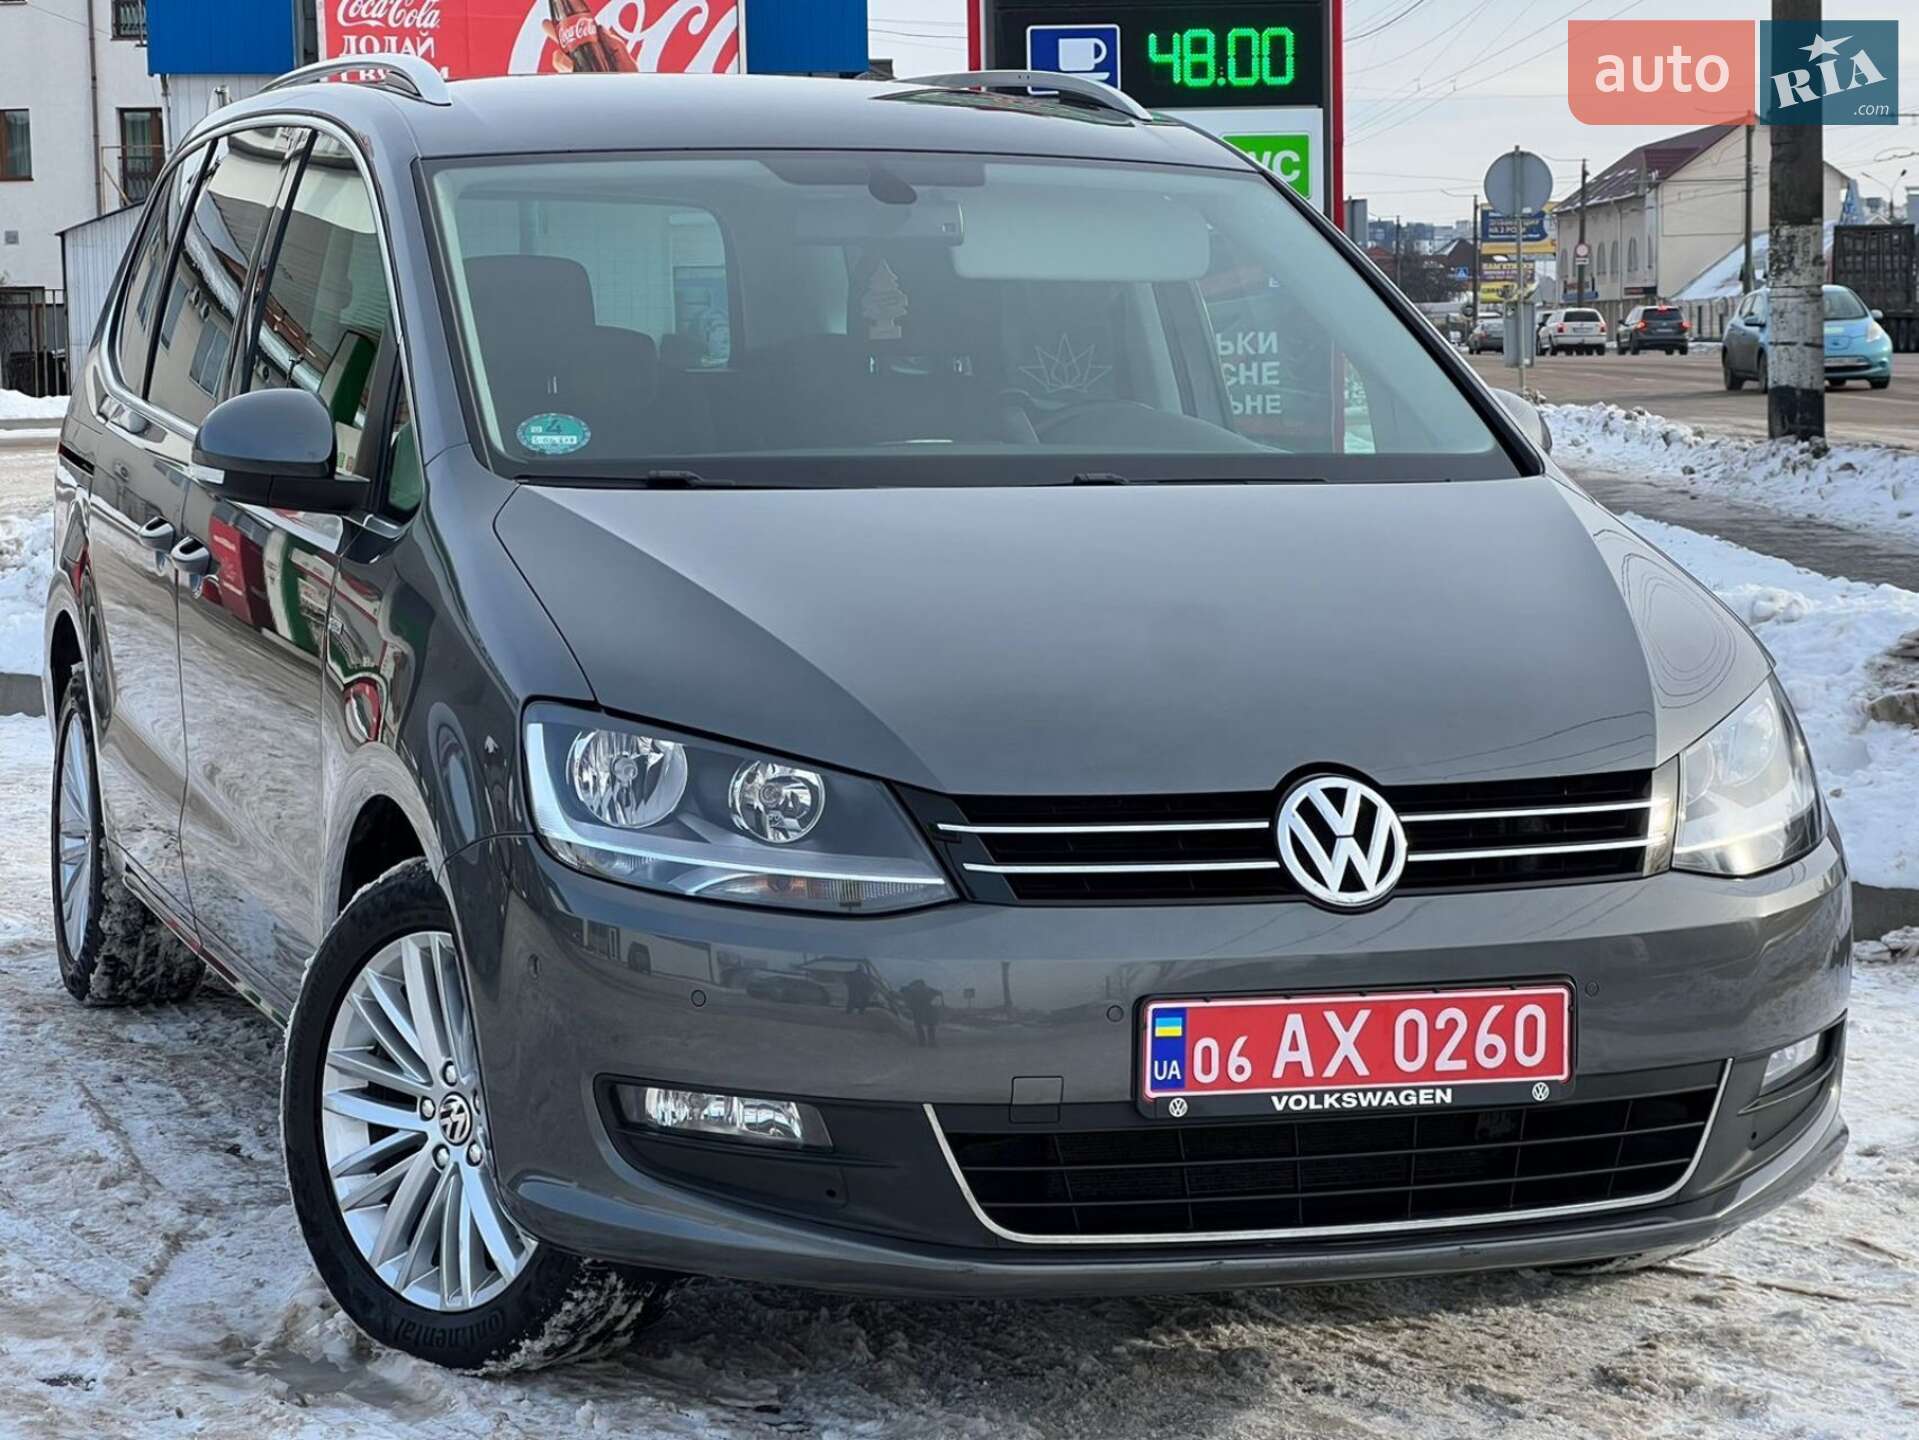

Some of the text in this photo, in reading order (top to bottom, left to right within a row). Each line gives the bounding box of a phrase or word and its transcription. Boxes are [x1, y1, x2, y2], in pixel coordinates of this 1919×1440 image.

[339, 30, 435, 59] ДОДАЙ
[1148, 27, 1295, 88] 48.00
[1192, 1003, 1547, 1084] 06 AX 0260
[1154, 1060, 1182, 1081] UA
[1271, 1088, 1453, 1112] VOLKSWAGEN
